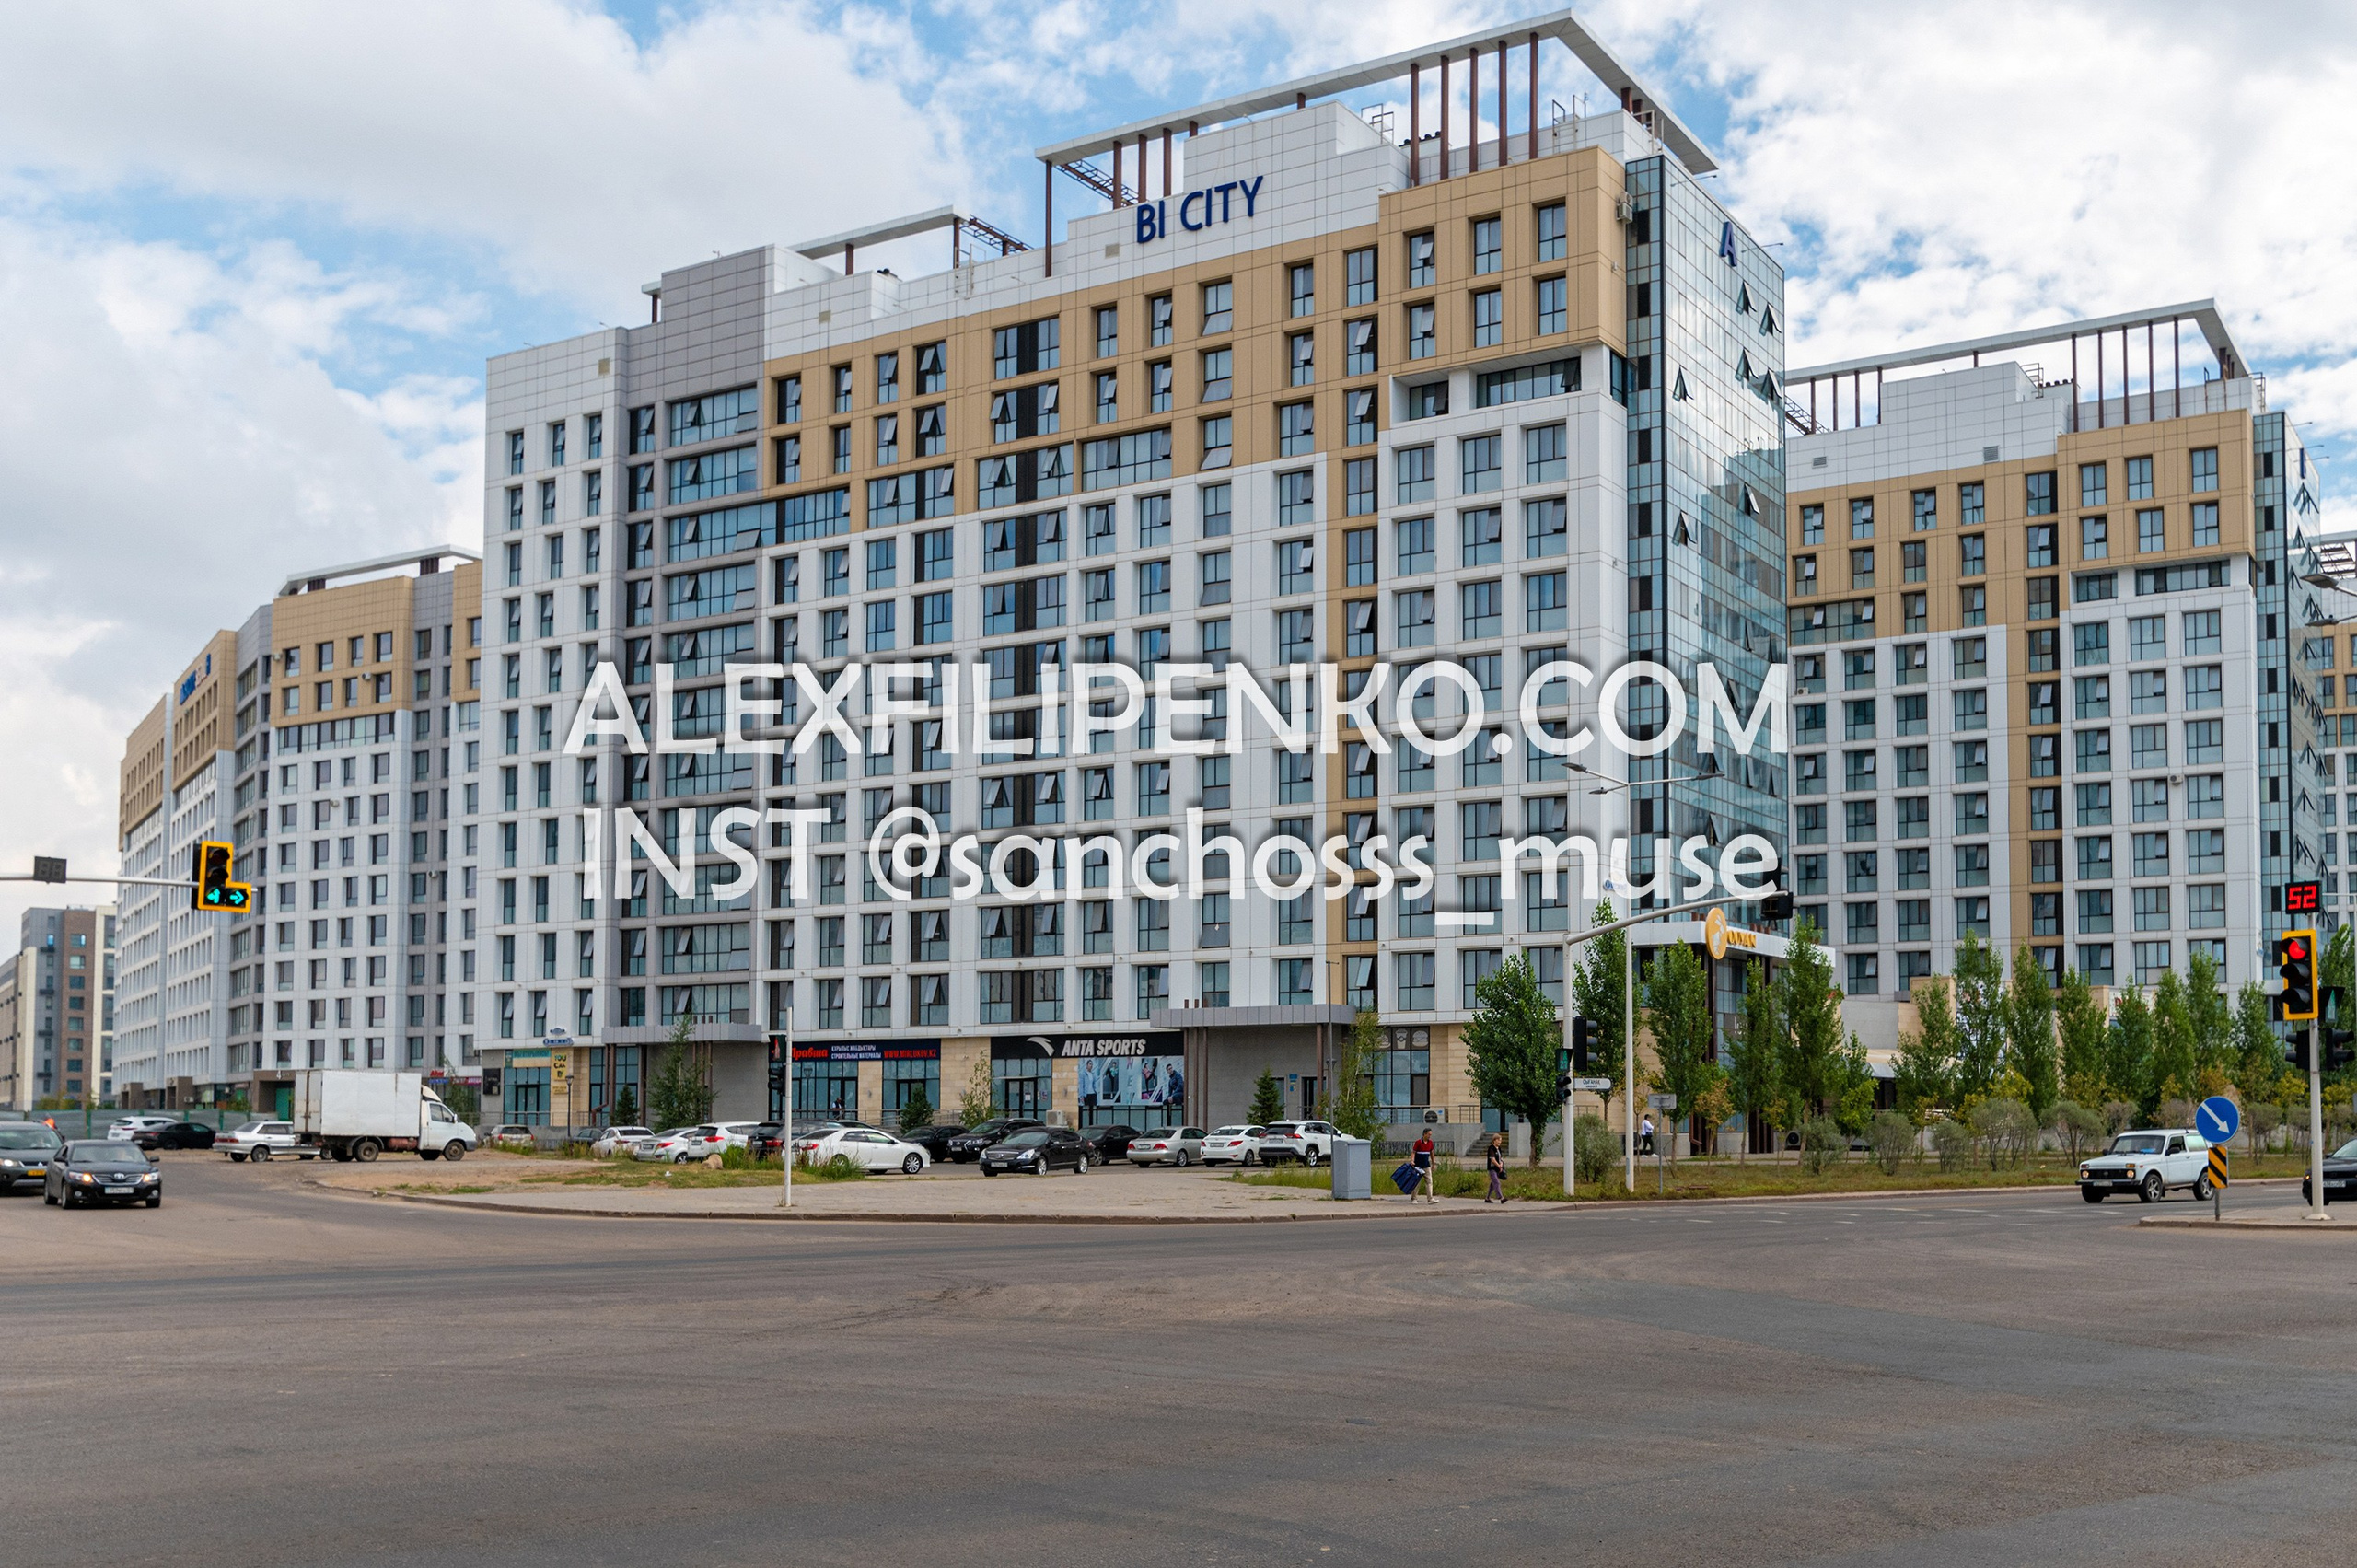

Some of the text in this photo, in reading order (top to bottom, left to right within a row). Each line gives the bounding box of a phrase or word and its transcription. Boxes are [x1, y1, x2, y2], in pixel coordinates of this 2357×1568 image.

[1136, 175, 1264, 244] BI CITY
[1719, 221, 1737, 267] A
[2288, 885, 2316, 910] 52
[1062, 1039, 1146, 1057] ANTA SPORTS
